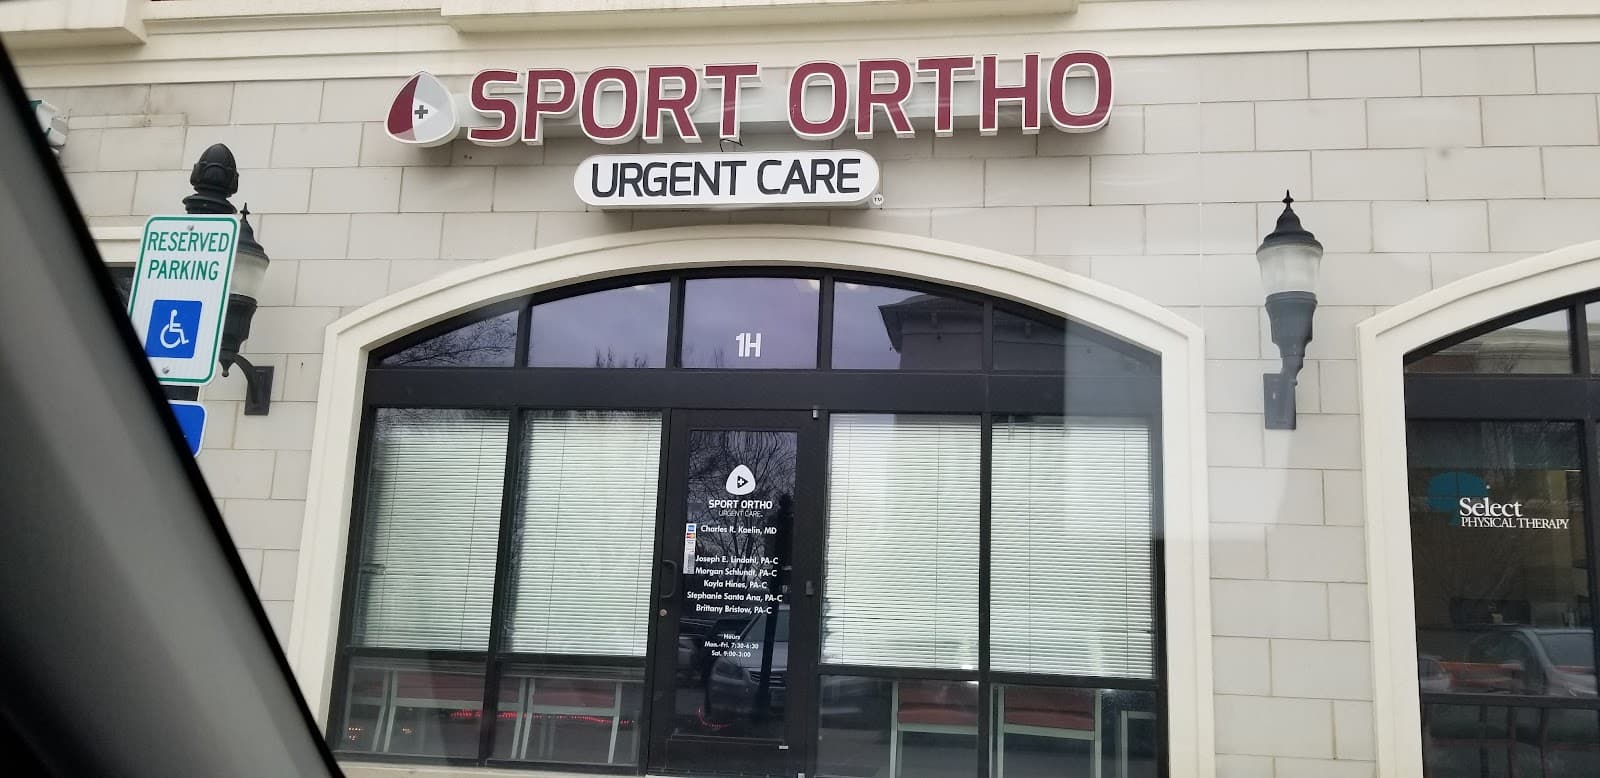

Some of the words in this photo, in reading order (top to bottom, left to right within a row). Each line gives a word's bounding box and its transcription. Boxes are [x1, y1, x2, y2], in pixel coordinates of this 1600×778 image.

[467, 63, 760, 143] SPORT
[788, 50, 1113, 138] ORTHO
[591, 160, 747, 198] URGENT
[757, 157, 861, 195] CARE
[147, 231, 230, 252] RESERVED
[147, 259, 220, 281] PARKING
[735, 332, 761, 358] 1H
[708, 499, 739, 509] SPORT
[740, 500, 773, 510] ORTHO
[1459, 497, 1524, 518] Select
[1461, 517, 1517, 528] PHYSICAL
[1518, 518, 1570, 530] THERAPY
[700, 524, 728, 533] Charles
[729, 525, 737, 534] R.
[738, 525, 763, 536] Kaelin,
[763, 526, 778, 535] MD
[695, 554, 720, 564] Joseph
[721, 555, 729, 563] E.
[730, 556, 760, 565] Lindahl,
[760, 557, 779, 565] PA-C
[695, 566, 724, 576] Morgan
[759, 569, 778, 577] PA-C
[703, 579, 724, 590] Kayla
[725, 580, 748, 590] Hines,
[749, 581, 768, 590] PA-C
[686, 591, 723, 601] Stephanie
[723, 592, 745, 601] Santa
[745, 593, 764, 603] Ana,
[764, 594, 784, 603] PA-C
[695, 603, 724, 615] Brittany
[724, 604, 753, 615] Bristow,
[753, 606, 773, 615] PA-C
